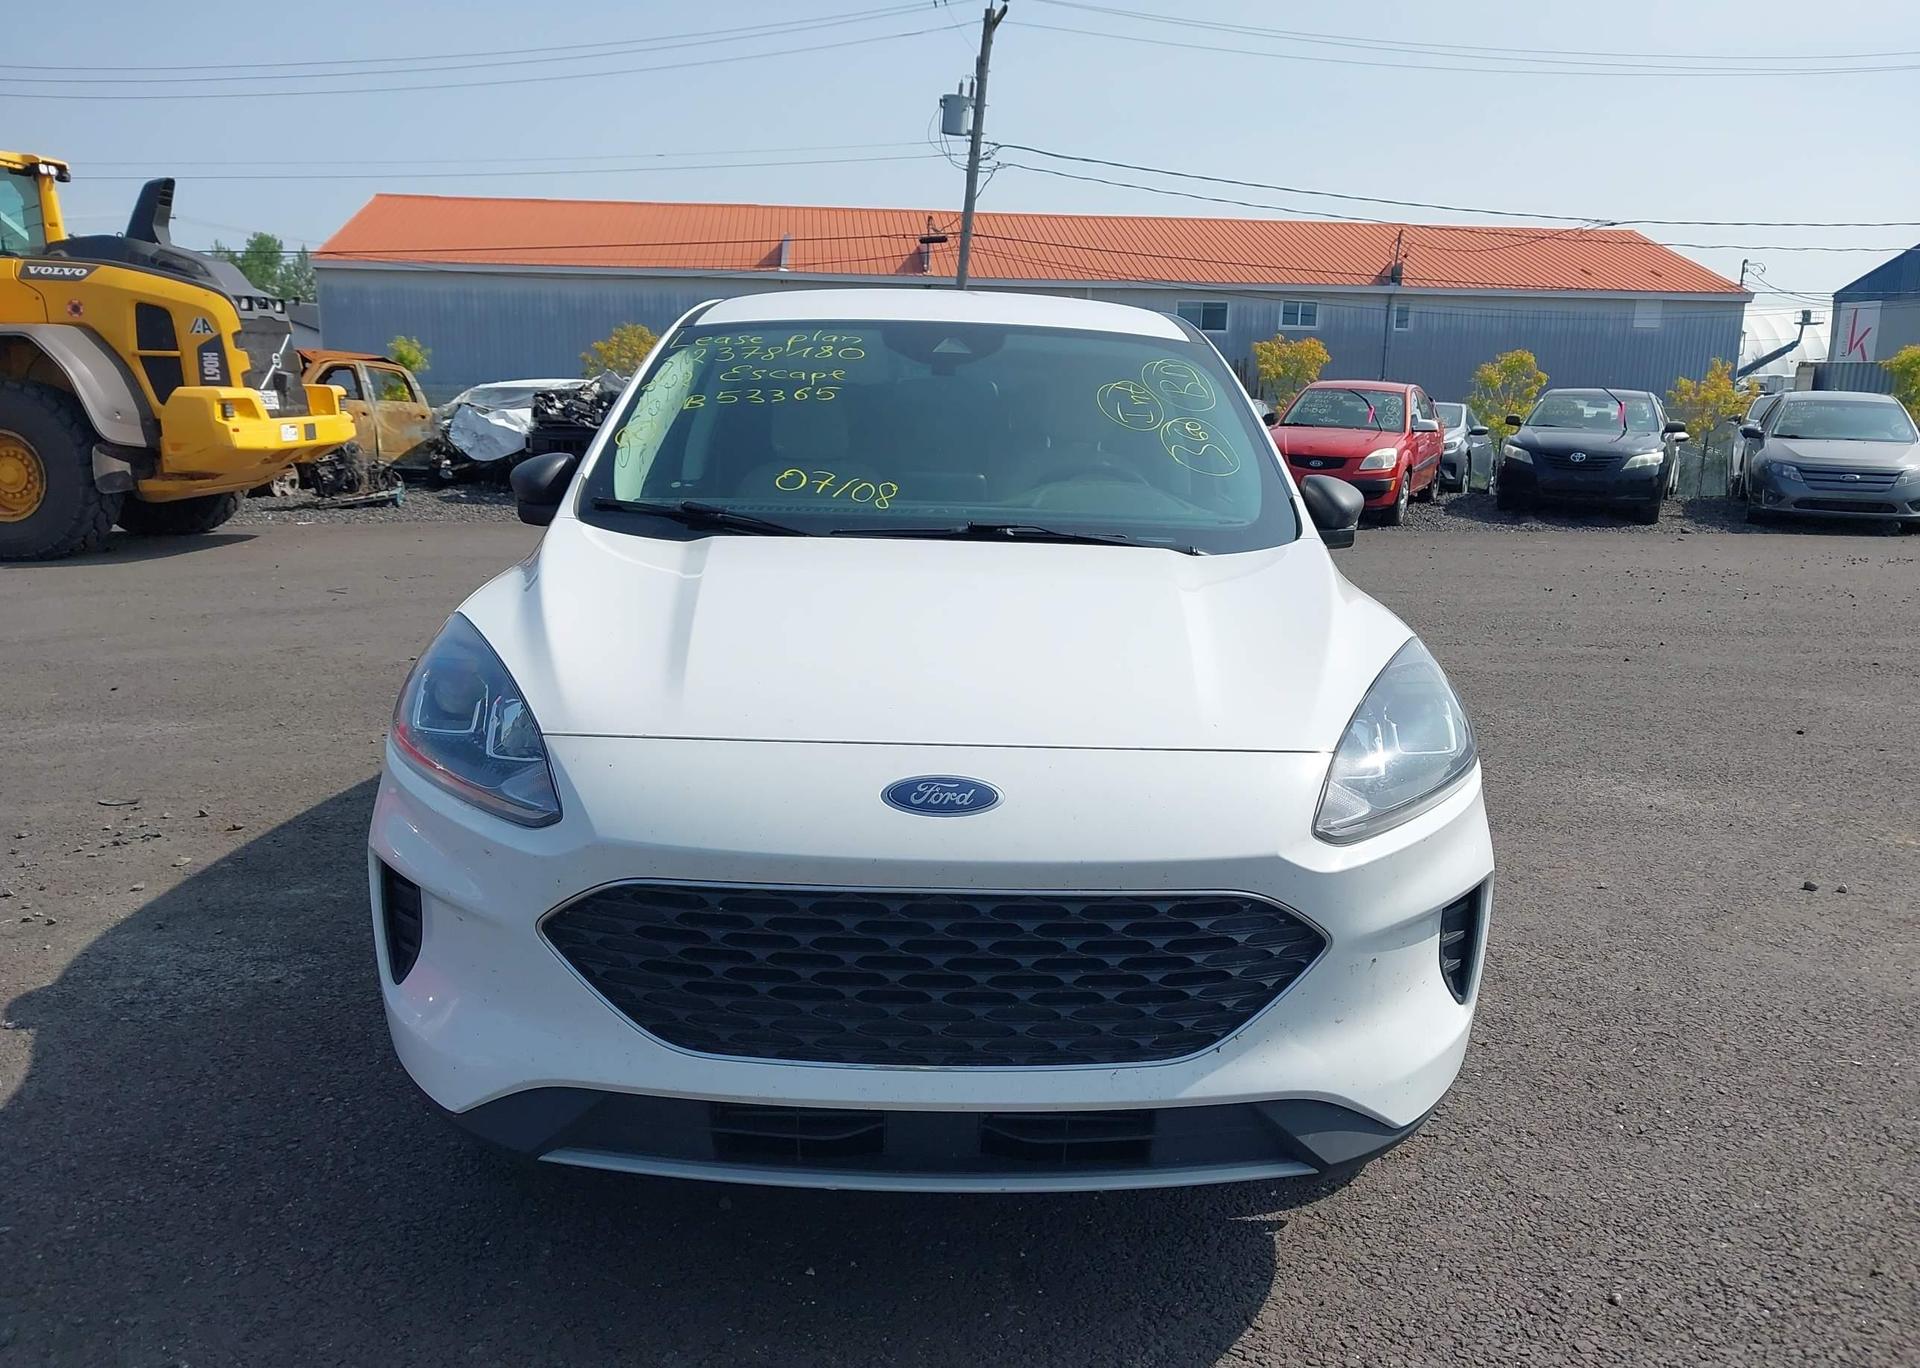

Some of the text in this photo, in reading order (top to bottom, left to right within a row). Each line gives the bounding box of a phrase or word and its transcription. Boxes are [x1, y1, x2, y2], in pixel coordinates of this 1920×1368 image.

[27, 265, 88, 276] VOLVO
[670, 330, 862, 352] Lease plan
[203, 352, 220, 380] L90H
[720, 365, 847, 386] Escape
[776, 468, 898, 509] 07/08
[910, 782, 976, 806] Ford
